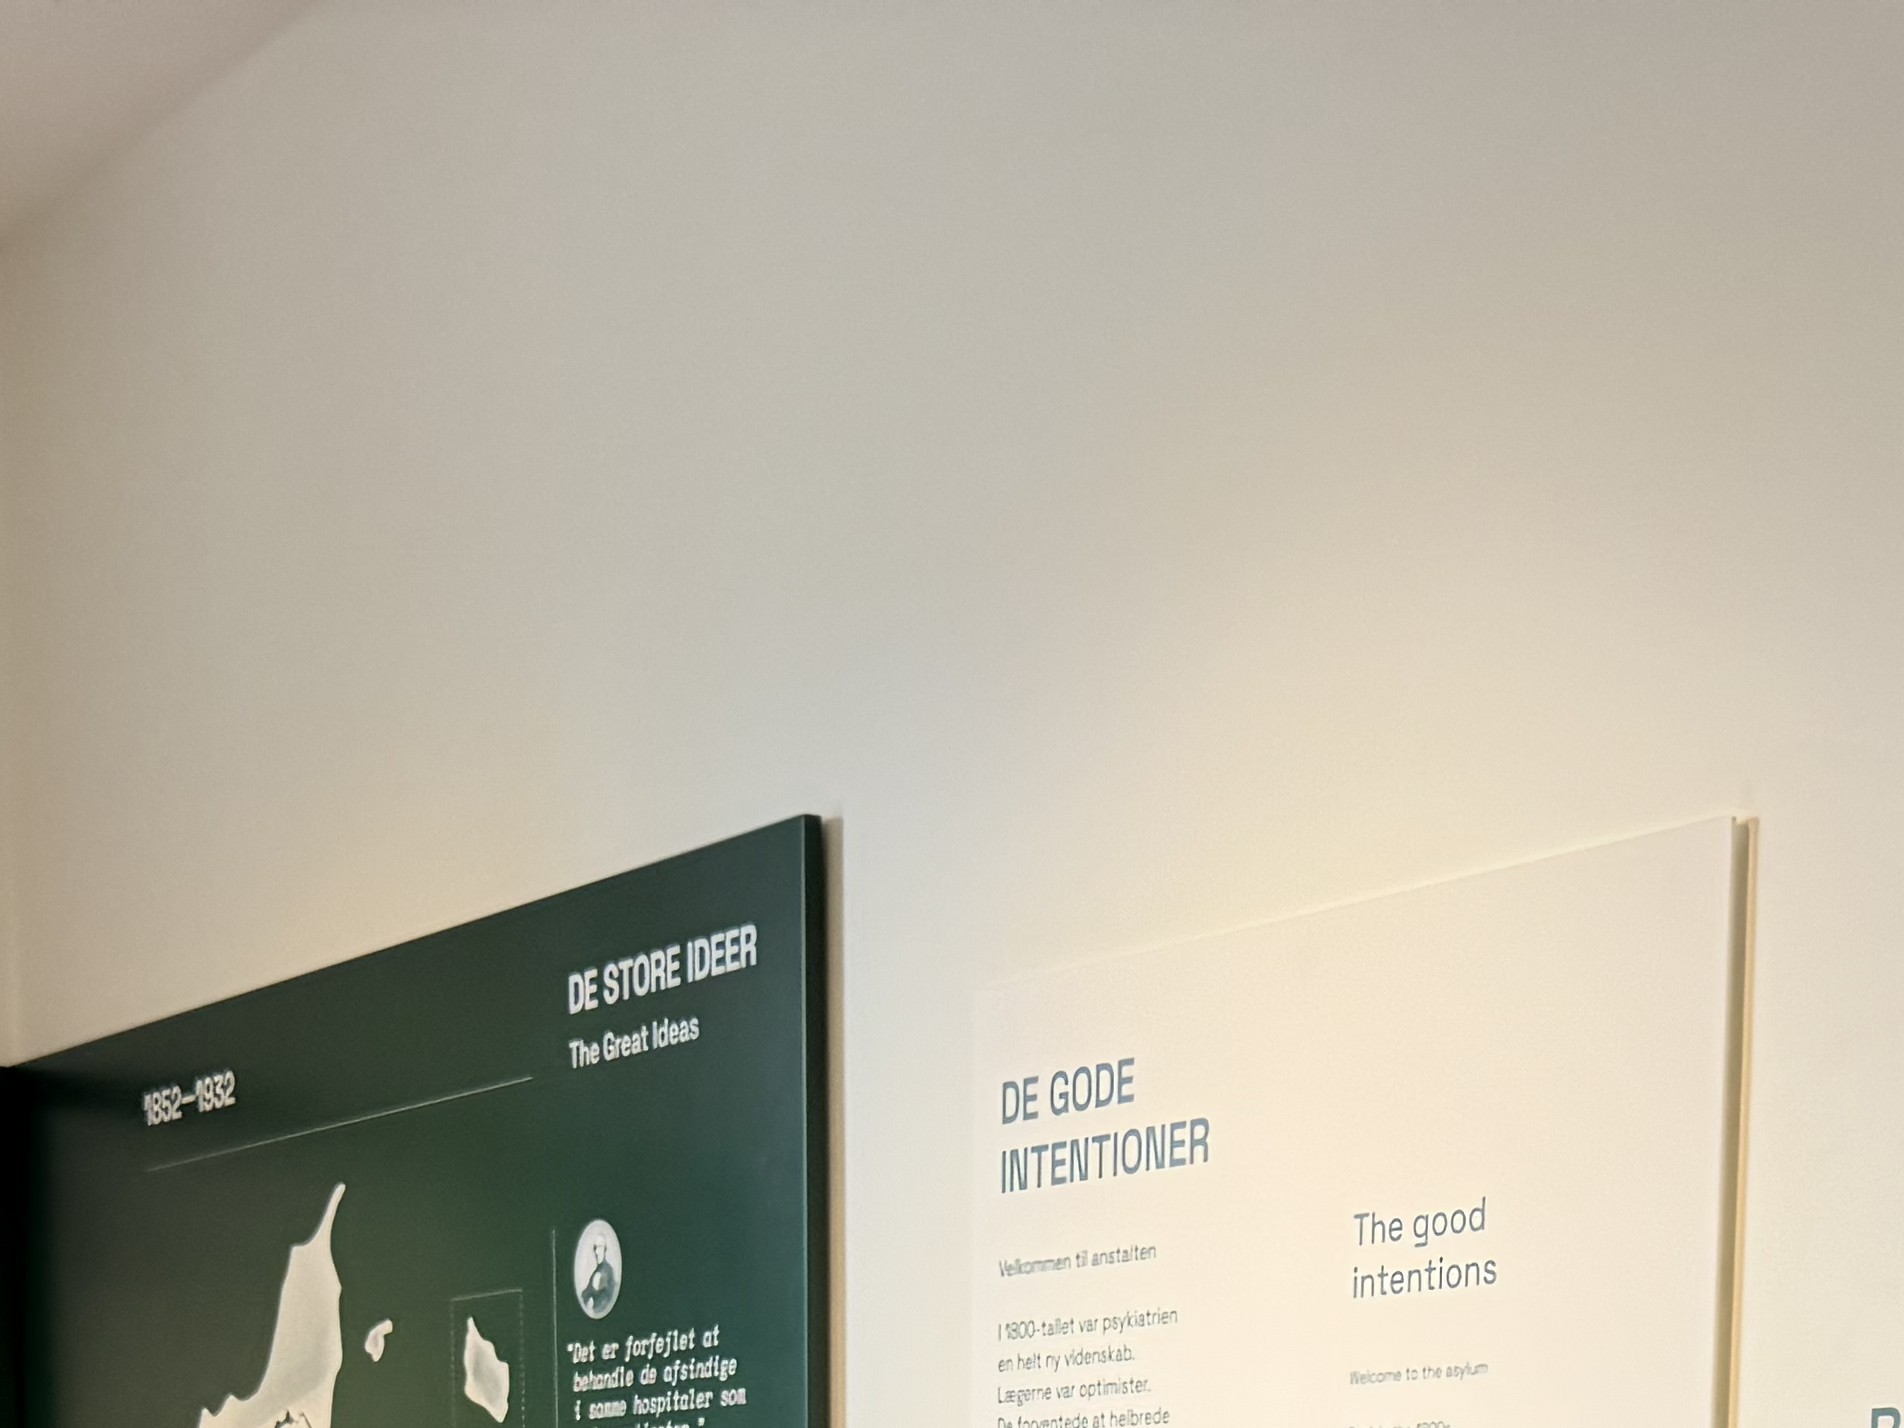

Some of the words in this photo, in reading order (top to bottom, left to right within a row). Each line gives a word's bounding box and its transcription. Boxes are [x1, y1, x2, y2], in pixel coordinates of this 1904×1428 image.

[569, 968, 598, 1015] DE
[603, 944, 681, 1005] STORE
[687, 923, 757, 982] IDEER
[569, 1040, 600, 1069] The
[603, 1025, 649, 1061] Great
[652, 1016, 700, 1049] Ideas
[1002, 1076, 1039, 1124] DE
[1050, 1058, 1135, 1116] GODE
[1001, 1117, 1209, 1194] INTENTIONER
[1354, 1212, 1403, 1246] The
[1413, 1196, 1486, 1247] good
[1091, 1245, 1156, 1267] anstalten
[1353, 1256, 1497, 1298] intentions
[1005, 1317, 1075, 1340] 1800-tallet
[1079, 1317, 1098, 1333] var
[1103, 1307, 1178, 1335] psykiatrien
[602, 1341, 619, 1360] er
[624, 1328, 695, 1362] forfejlet
[702, 1324, 719, 1348] at
[998, 1358, 1013, 1372] en
[1017, 1353, 1041, 1370] helt
[1046, 1355, 1060, 1372] ny
[1064, 1344, 1135, 1366] videnskab.
[573, 1367, 634, 1392] behandle
[640, 1364, 657, 1385] de
[663, 1355, 737, 1386] afsindige
[1423, 1366, 1442, 1380] the
[1446, 1362, 1488, 1380] asylum
[589, 1400, 627, 1419] samme
[633, 1388, 714, 1418] hospitaler
[720, 1388, 746, 1407] som
[998, 1387, 1051, 1406] Lægerne
[1056, 1385, 1075, 1399] var
[1079, 1377, 1151, 1400] optimister.
[1093, 1414, 1105, 1428] at
[1110, 1407, 1170, 1427] helbrede
